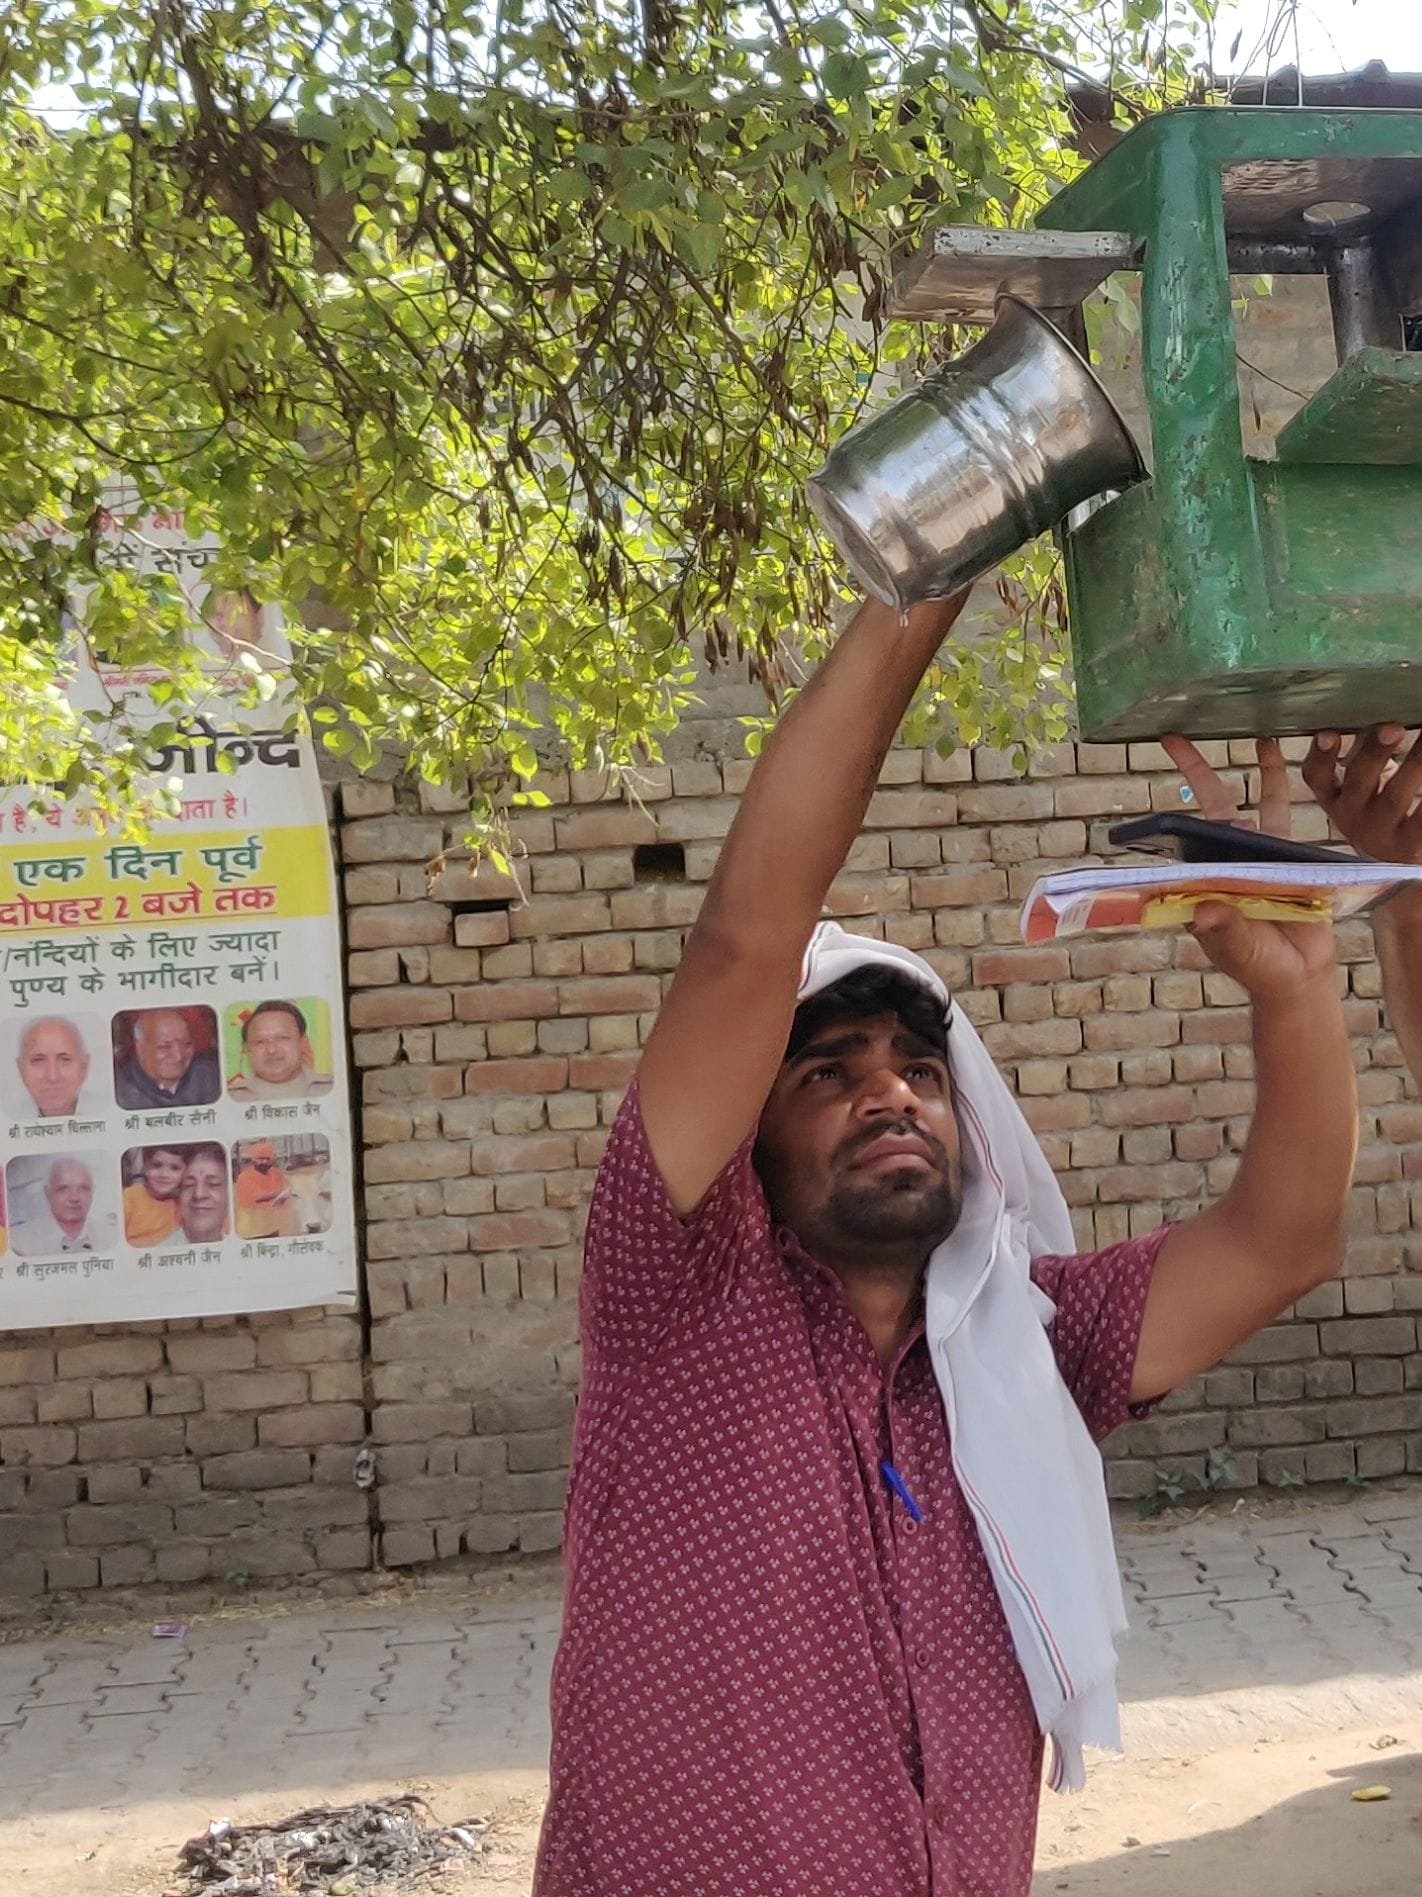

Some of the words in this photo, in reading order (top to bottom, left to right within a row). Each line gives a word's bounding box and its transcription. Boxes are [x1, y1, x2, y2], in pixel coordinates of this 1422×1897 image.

[13, 856, 87, 887] एक
[104, 845, 183, 880] दिन
[200, 835, 263, 883] पूर्व
[0, 892, 104, 927] दोपहर
[115, 895, 130, 919] 2
[141, 879, 203, 916] बजे
[213, 885, 278, 912] तक
[110, 933, 136, 961] के
[147, 932, 198, 959] लिए
[208, 930, 282, 953] ज्यादा
[9, 975, 68, 1008] पुण्य
[78, 966, 105, 995] के
[118, 962, 220, 991] भागीदार
